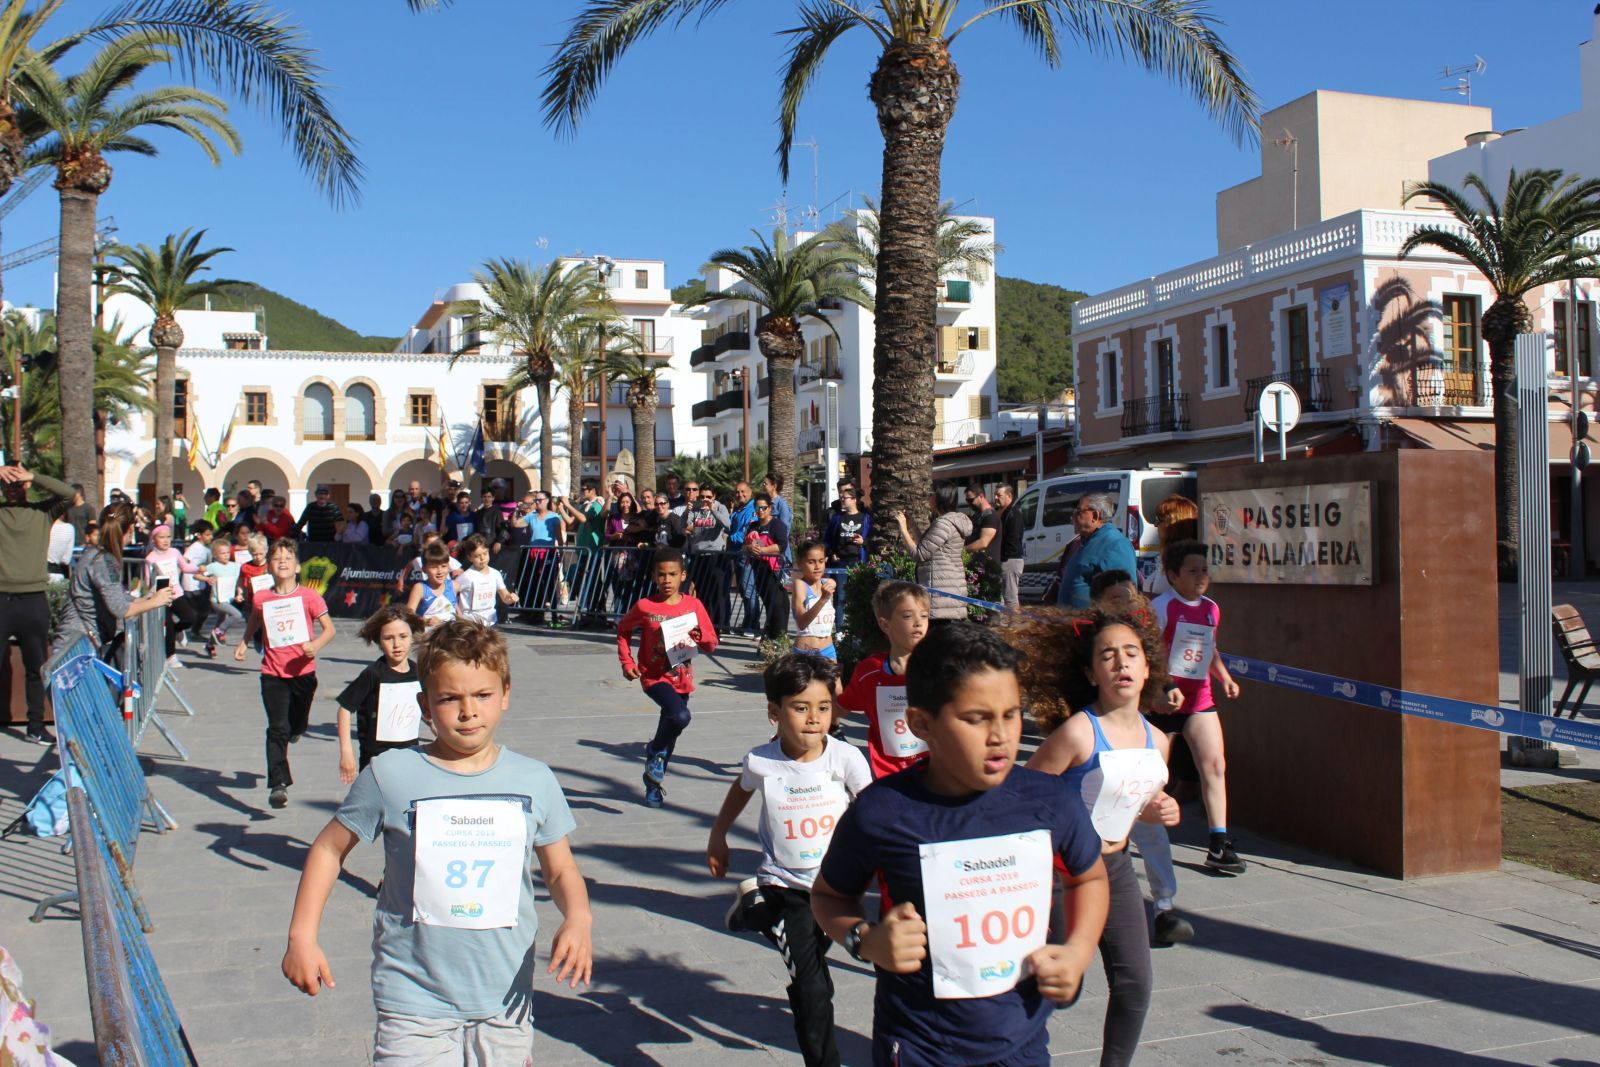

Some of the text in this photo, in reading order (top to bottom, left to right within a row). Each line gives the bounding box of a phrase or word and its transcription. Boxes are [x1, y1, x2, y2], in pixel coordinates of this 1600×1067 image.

[1243, 501, 1342, 529] PASSEIG
[1211, 540, 1361, 566] DE S'ALAMERA
[340, 567, 394, 580] Ajuntament
[277, 619, 294, 632] 37
[1183, 648, 1204, 662] 85
[789, 785, 822, 794] Sabadell
[450, 815, 494, 825] Sabadell
[783, 814, 835, 840] 109
[432, 840, 468, 848] PASSEIG
[963, 855, 1017, 872] Sabadell
[444, 859, 496, 889] 87
[959, 874, 993, 886] CURSA
[944, 880, 1040, 900] PASSEIG A PASSEIG
[953, 905, 1036, 949] 100
